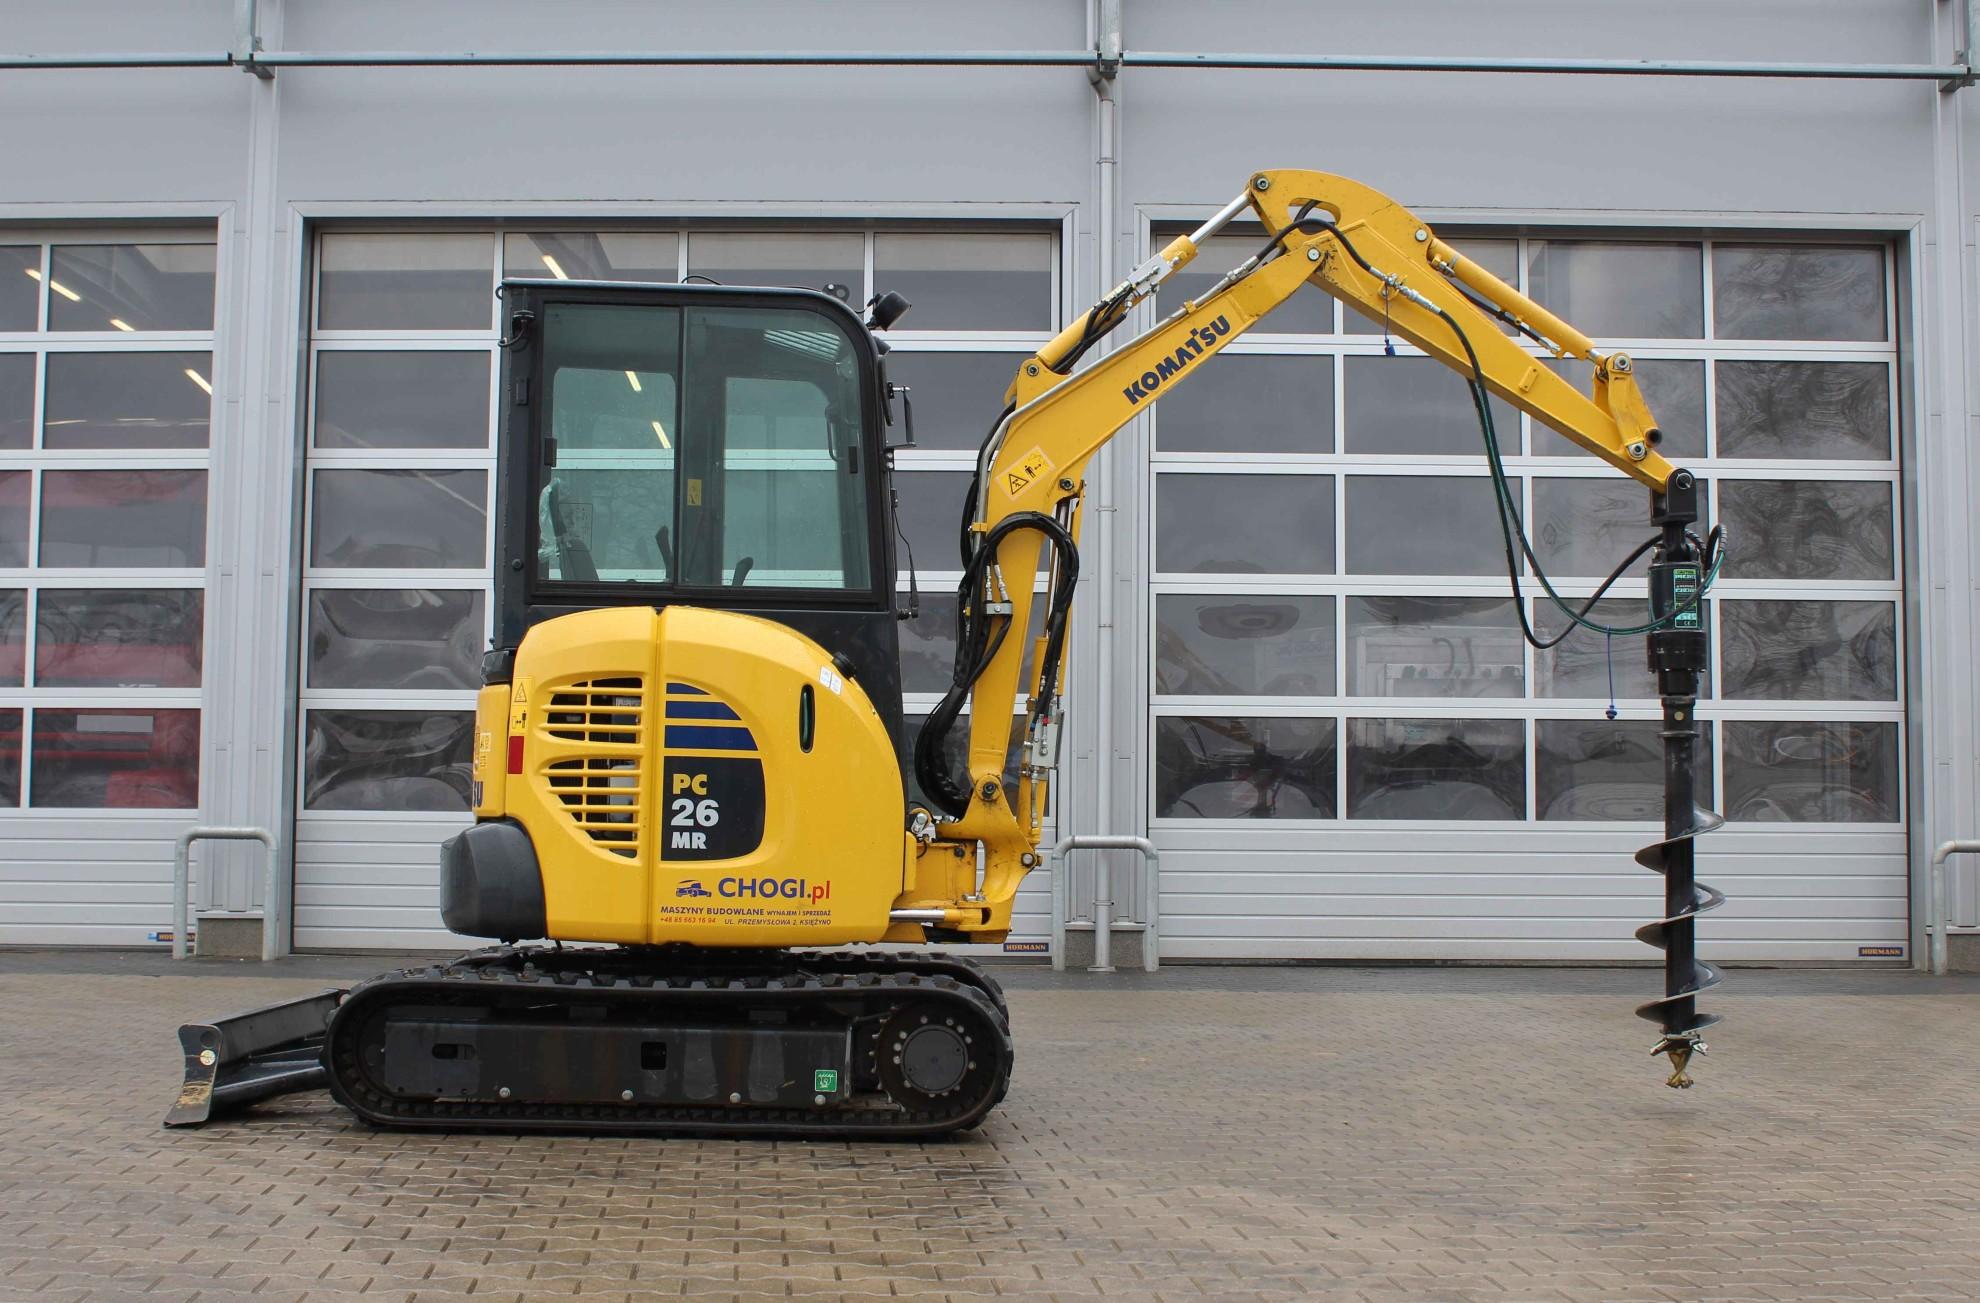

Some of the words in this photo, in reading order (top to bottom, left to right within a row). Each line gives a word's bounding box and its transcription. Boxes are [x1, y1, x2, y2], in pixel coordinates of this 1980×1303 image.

[1123, 315, 1231, 405] KOMATSU
[672, 773, 708, 795] PC
[671, 798, 719, 827] 26
[671, 832, 707, 849] MR
[718, 877, 831, 904] CHOGI.pl
[660, 906, 704, 915] MASZYNY
[706, 907, 765, 916] BUDOWLANE
[737, 918, 791, 926] PRZEMYSŁOWA
